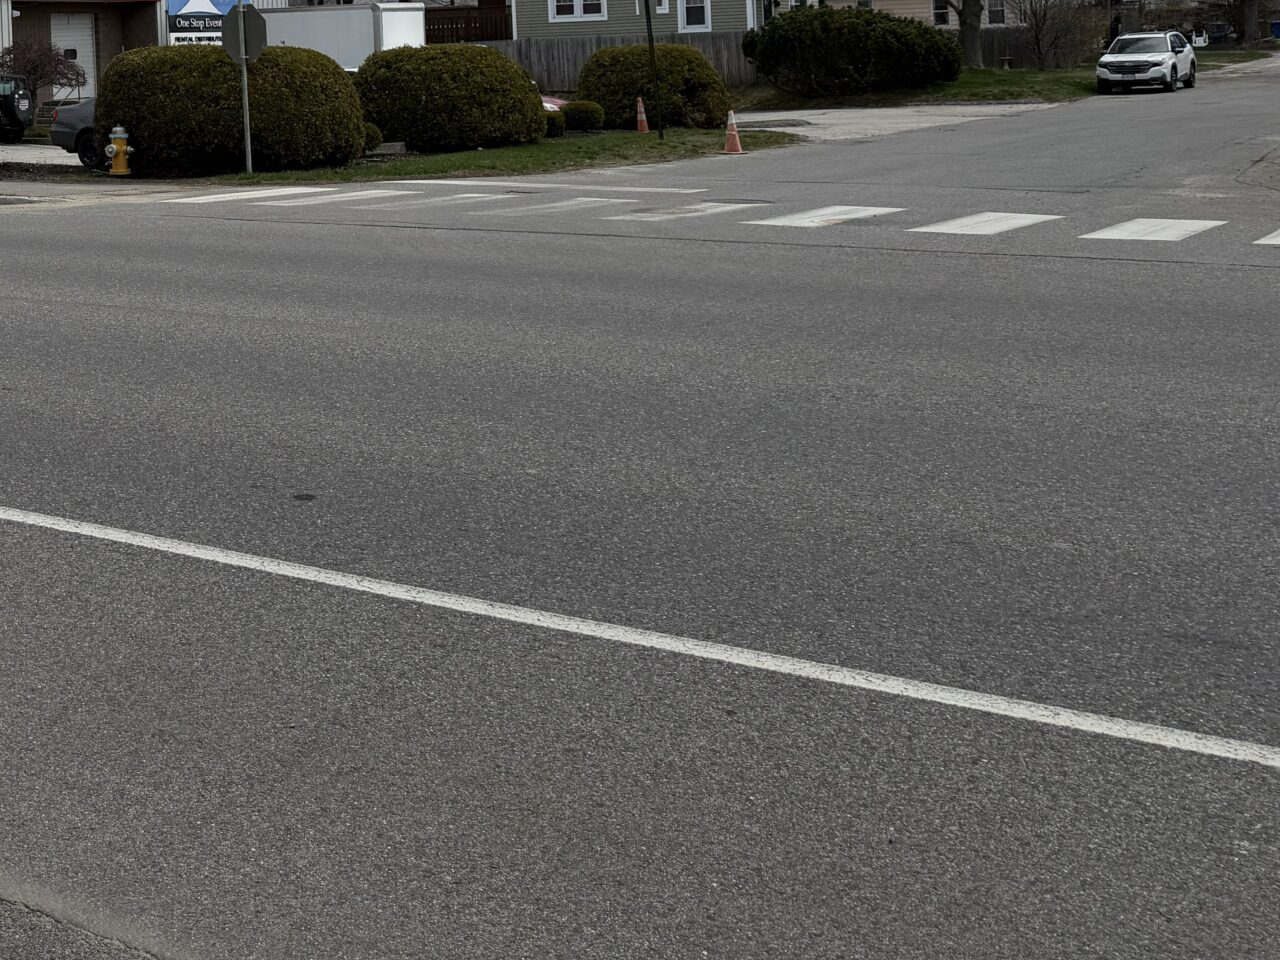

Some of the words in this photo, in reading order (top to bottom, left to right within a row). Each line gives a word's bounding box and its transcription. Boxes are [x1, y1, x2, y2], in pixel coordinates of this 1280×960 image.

[176, 18, 189, 28] One
[190, 17, 205, 30] Stop
[205, 17, 222, 28] Event
